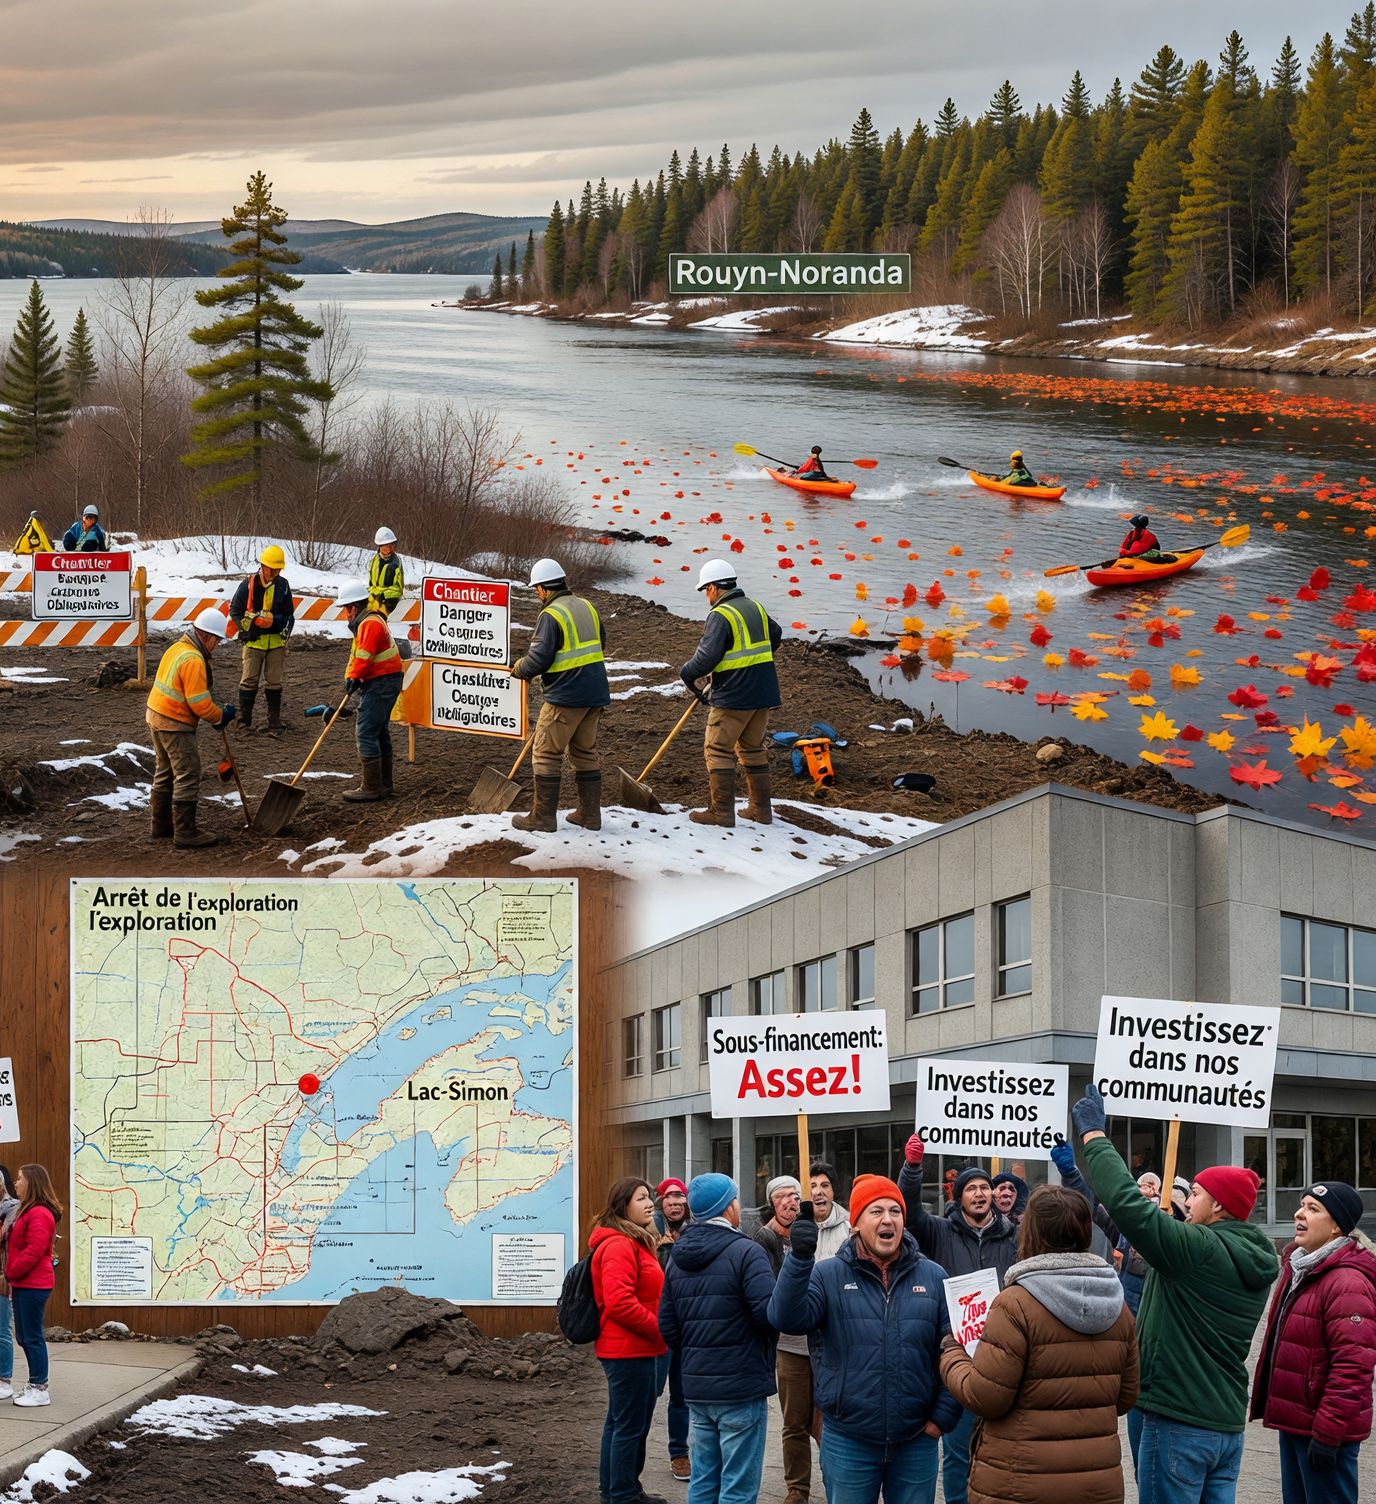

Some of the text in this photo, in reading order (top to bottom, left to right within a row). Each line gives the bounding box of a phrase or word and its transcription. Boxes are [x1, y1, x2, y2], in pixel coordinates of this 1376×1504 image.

[676, 258, 903, 291] Rouyn-Noranda
[92, 886, 298, 915] Arrêt de l'exploration
[89, 909, 216, 936] l'exploration
[713, 1025, 883, 1054] Sous-financement:
[1109, 1007, 1265, 1046] Investissez
[1129, 1042, 1239, 1076] dans nos
[408, 1080, 508, 1101] Lac-Simon
[737, 1054, 862, 1099] Assez!
[927, 1066, 1055, 1096] Investissez
[944, 1095, 1038, 1122] dans nos
[1097, 1077, 1266, 1110] communautés
